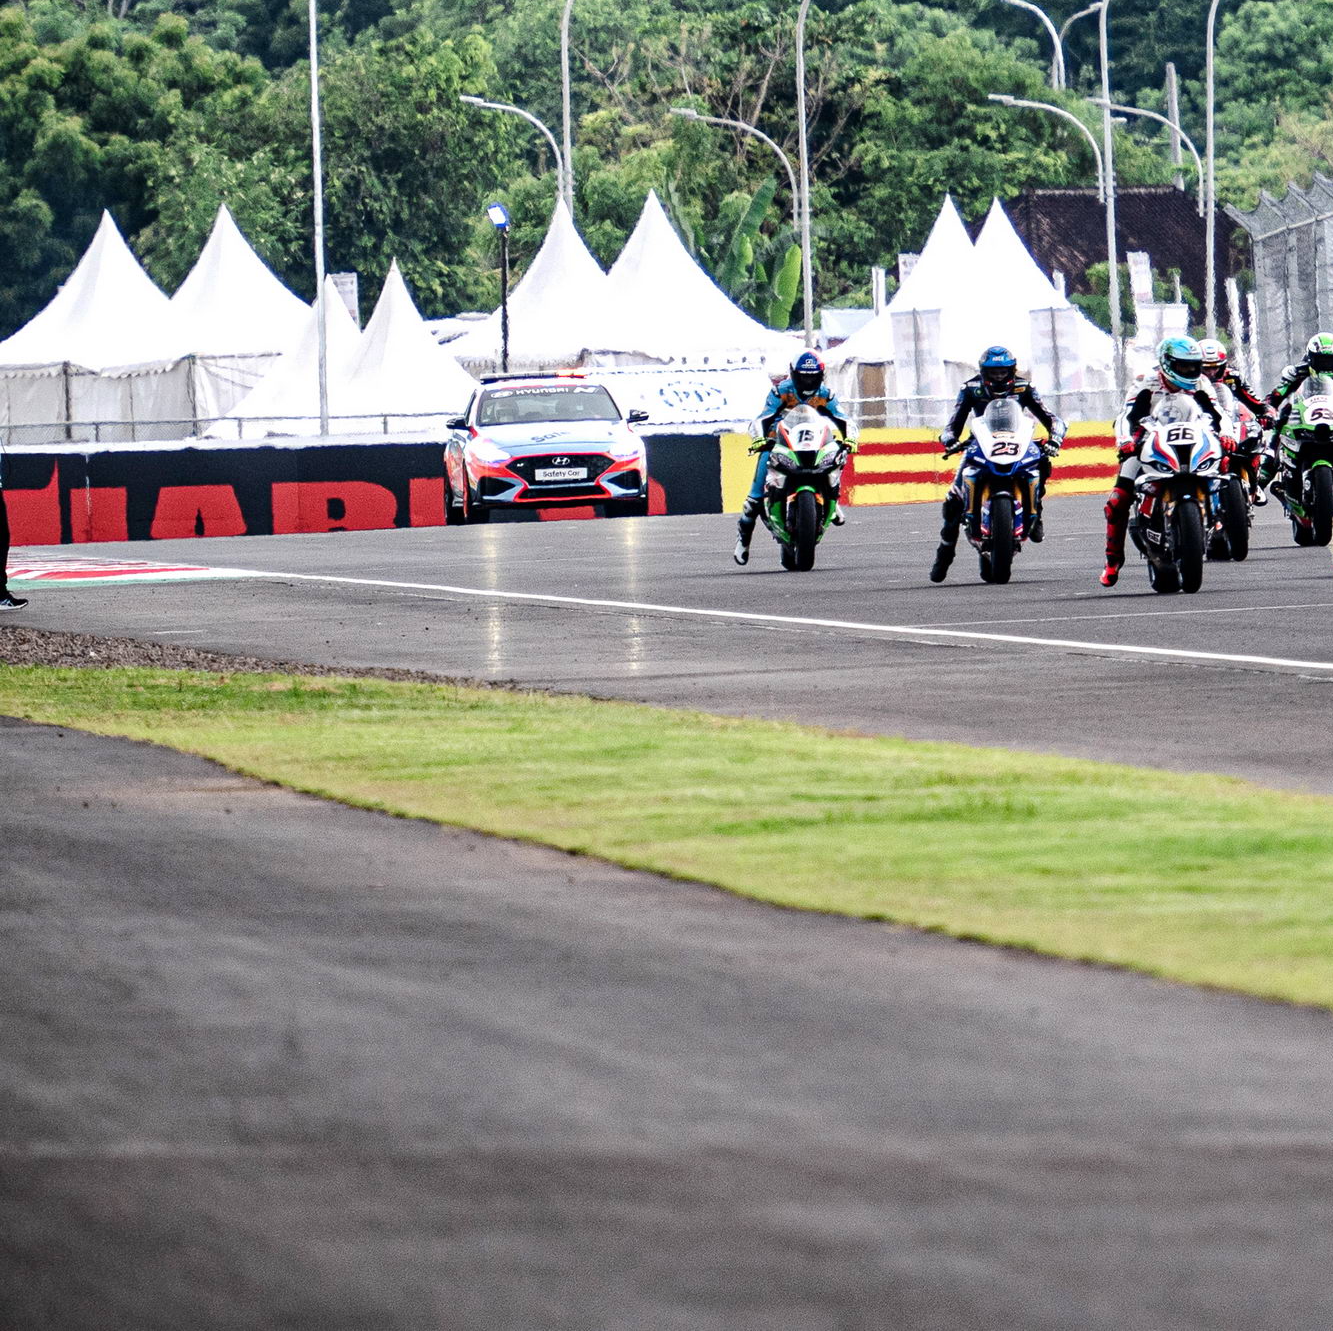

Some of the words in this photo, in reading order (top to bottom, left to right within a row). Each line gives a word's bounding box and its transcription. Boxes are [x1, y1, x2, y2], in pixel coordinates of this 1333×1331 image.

[1310, 408, 1333, 421] 53
[798, 429, 815, 442] 15
[1167, 428, 1195, 442] 66
[991, 442, 1020, 457] 23
[543, 470, 566, 478] Safety
